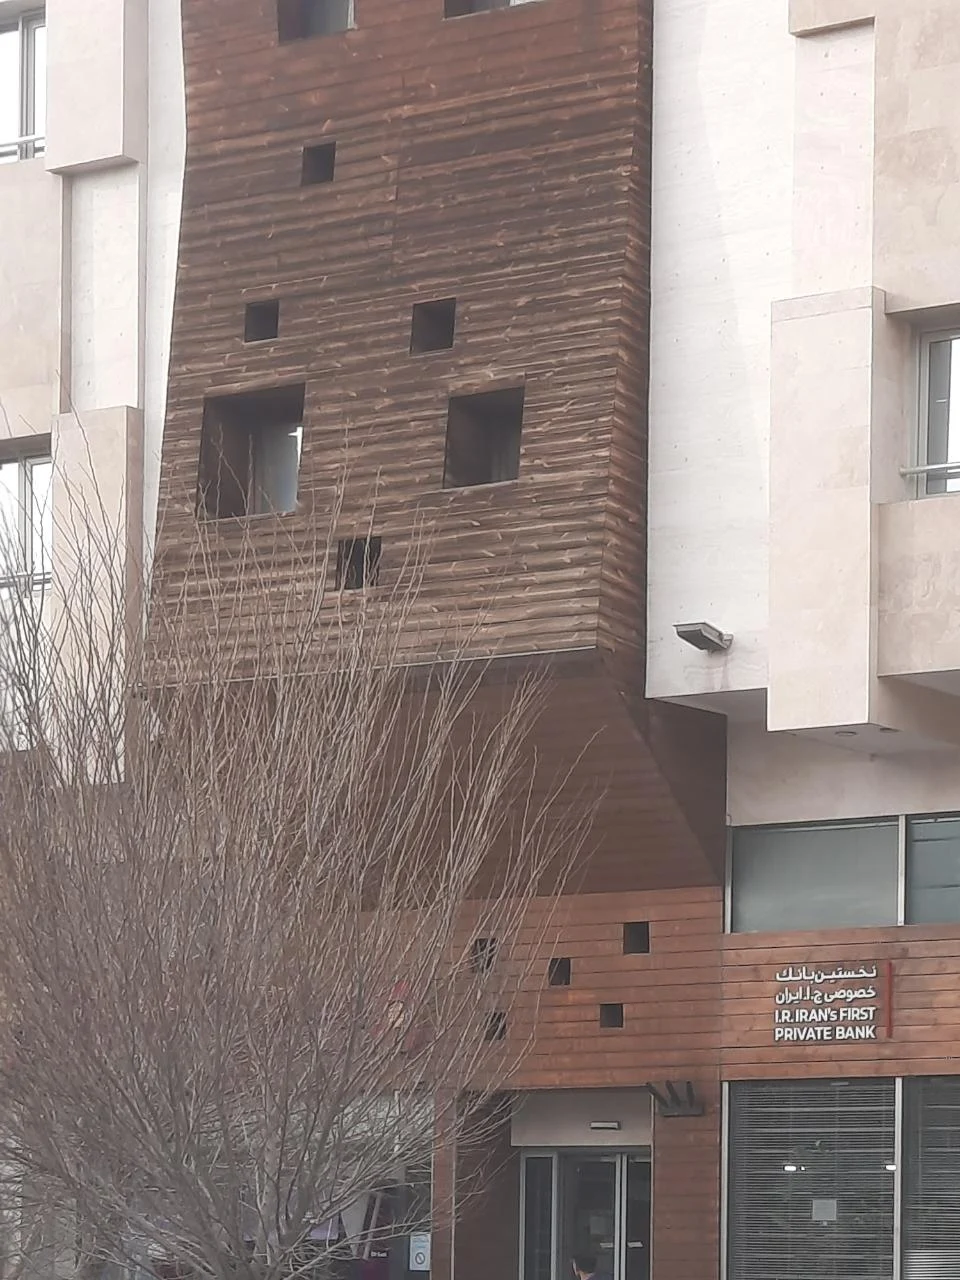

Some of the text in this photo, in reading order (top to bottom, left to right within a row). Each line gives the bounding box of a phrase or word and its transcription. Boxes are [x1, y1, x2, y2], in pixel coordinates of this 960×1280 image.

[814, 965, 877, 984] نخستین
[824, 986, 876, 1003] خصوصی
[839, 1006, 876, 1021] FIRST
[774, 1025, 876, 1041] PRIVATE BANK
